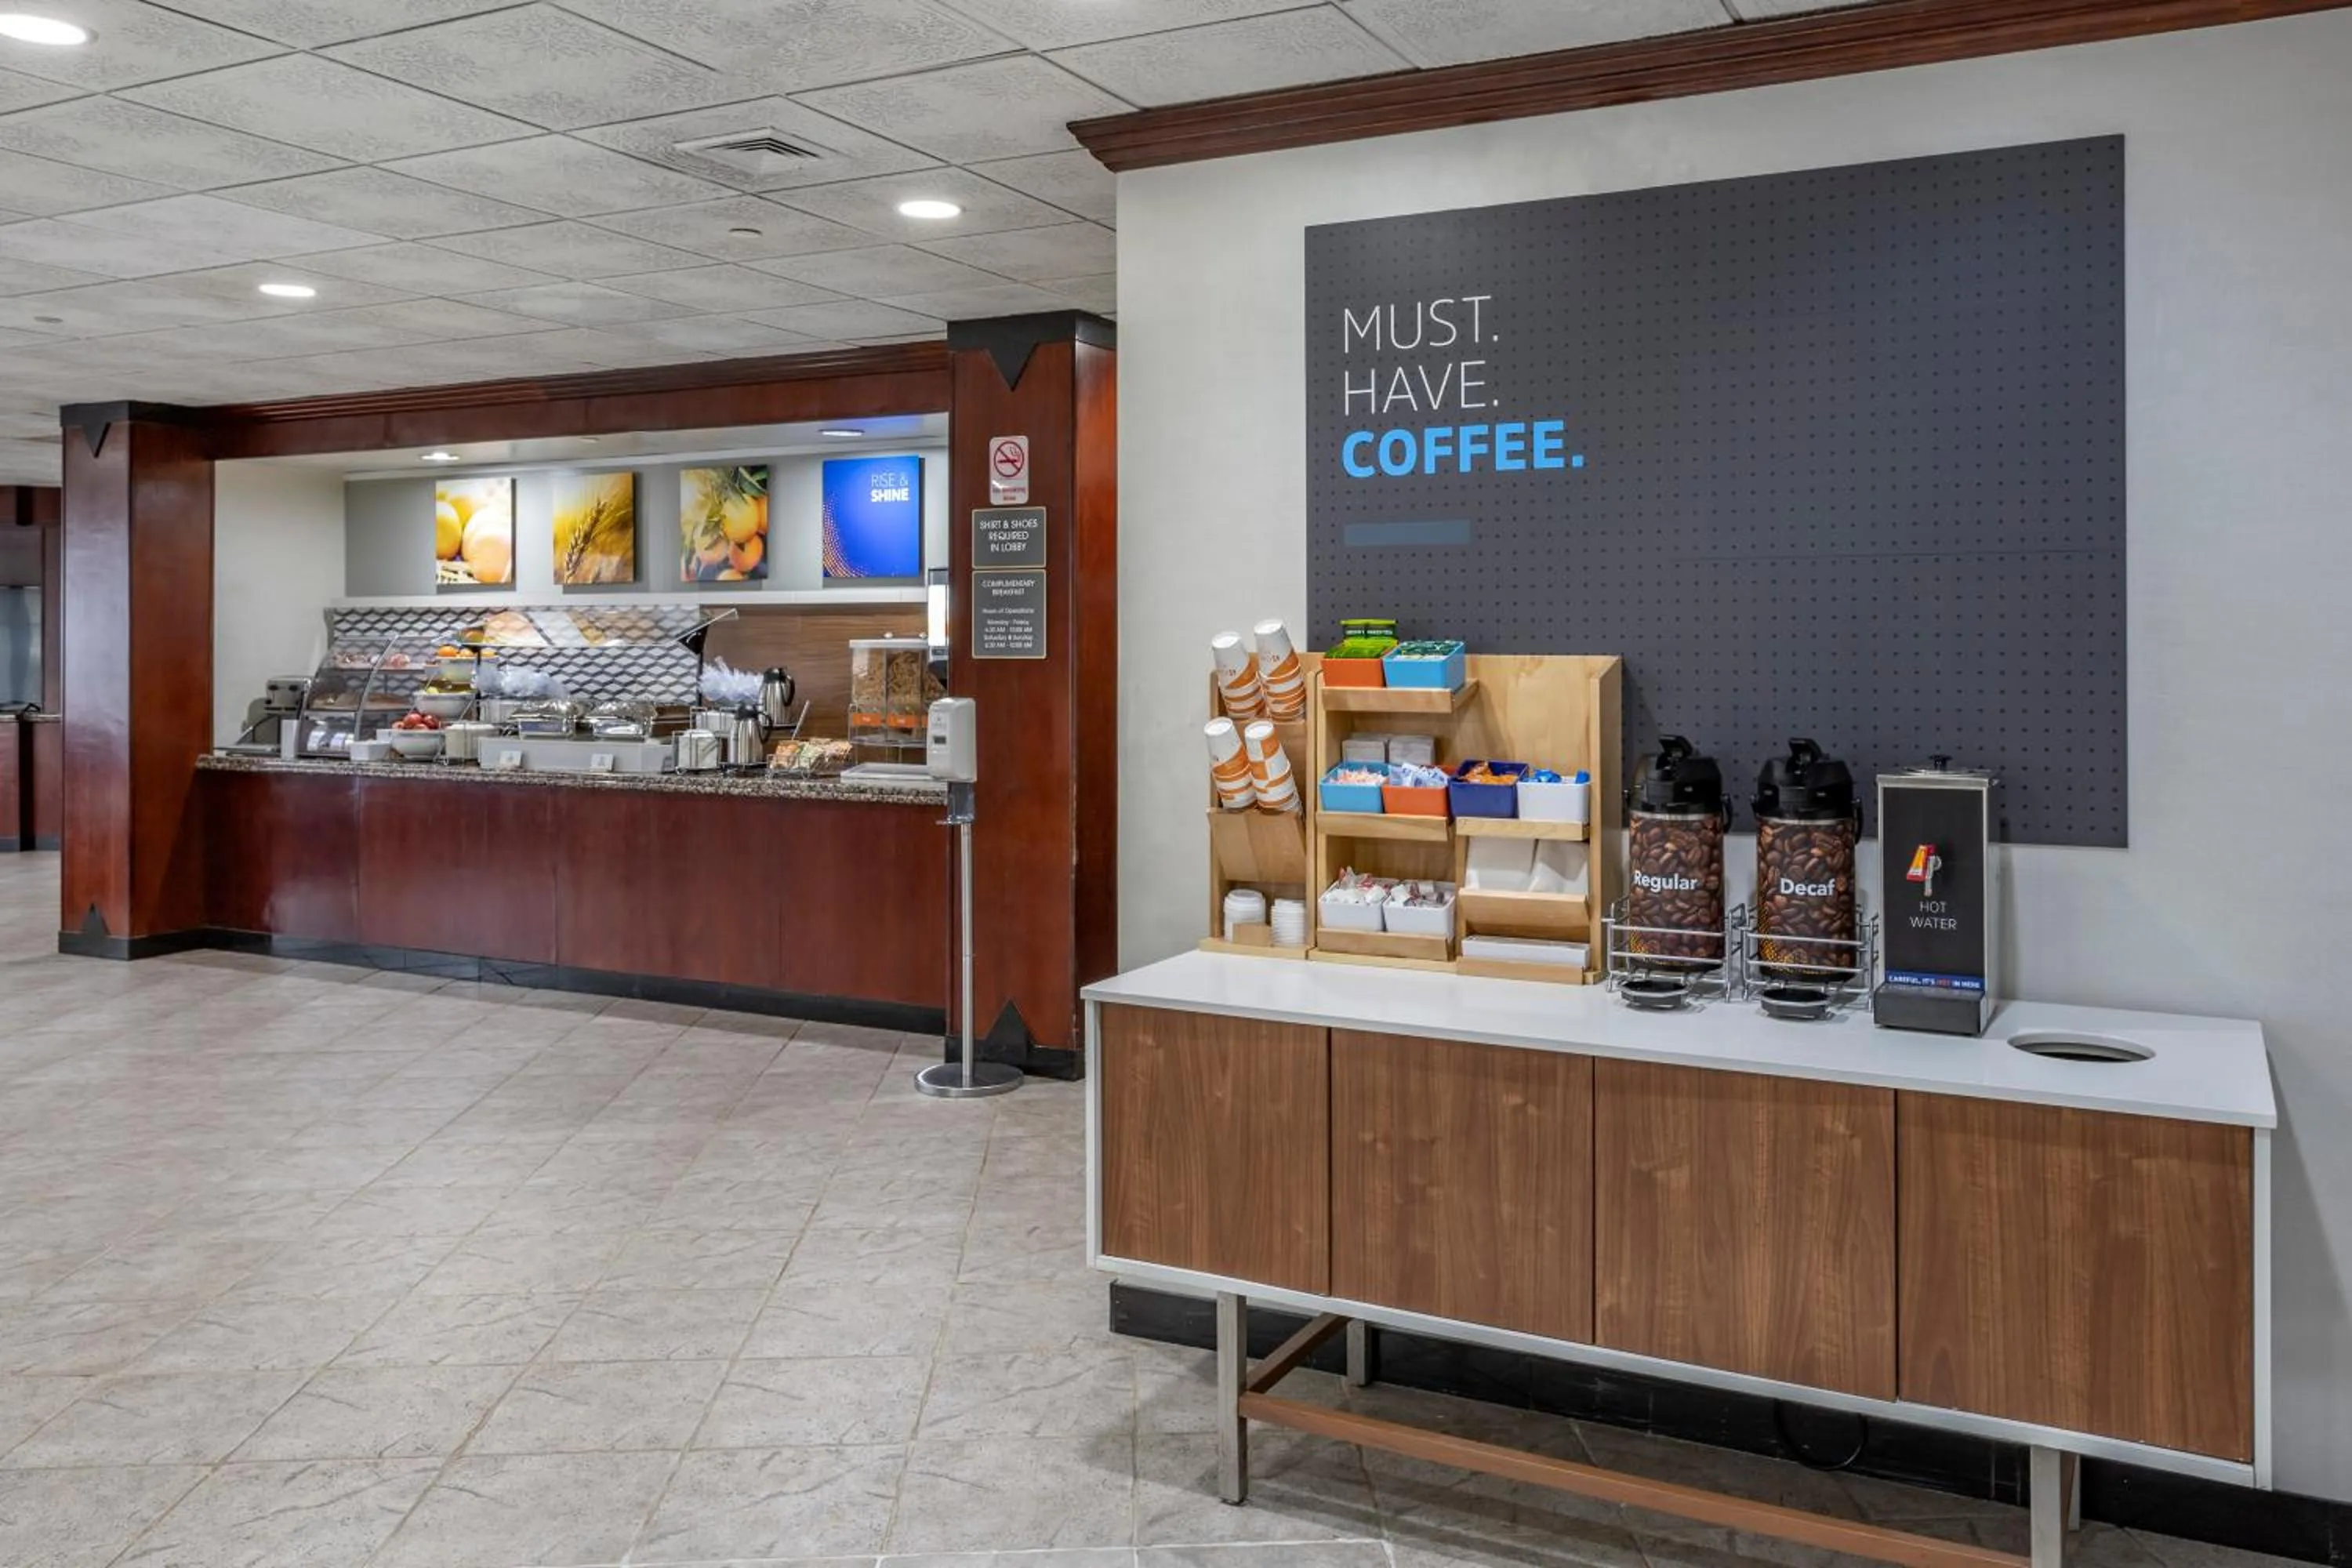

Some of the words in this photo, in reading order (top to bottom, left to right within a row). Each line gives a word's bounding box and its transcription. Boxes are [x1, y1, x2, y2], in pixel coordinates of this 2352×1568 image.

[1344, 295, 1499, 354] MUST.
[1344, 360, 1499, 416] HAVE.
[1341, 419, 1584, 478] COFFEE.
[871, 473, 895, 488] RISE
[899, 472, 909, 486] &
[871, 488, 909, 503] SHINE
[979, 520, 1001, 529] SHIRT
[1003, 520, 1009, 528] &
[1011, 518, 1038, 528] SHOES
[989, 531, 1029, 540] REQUIRED
[990, 543, 1000, 552] IN
[1001, 543, 1027, 552] LOBBY
[1634, 870, 1697, 892] Regular
[1780, 878, 1835, 896] Decaf
[1918, 901, 1947, 913] HOT
[1909, 916, 1958, 930] WATER
